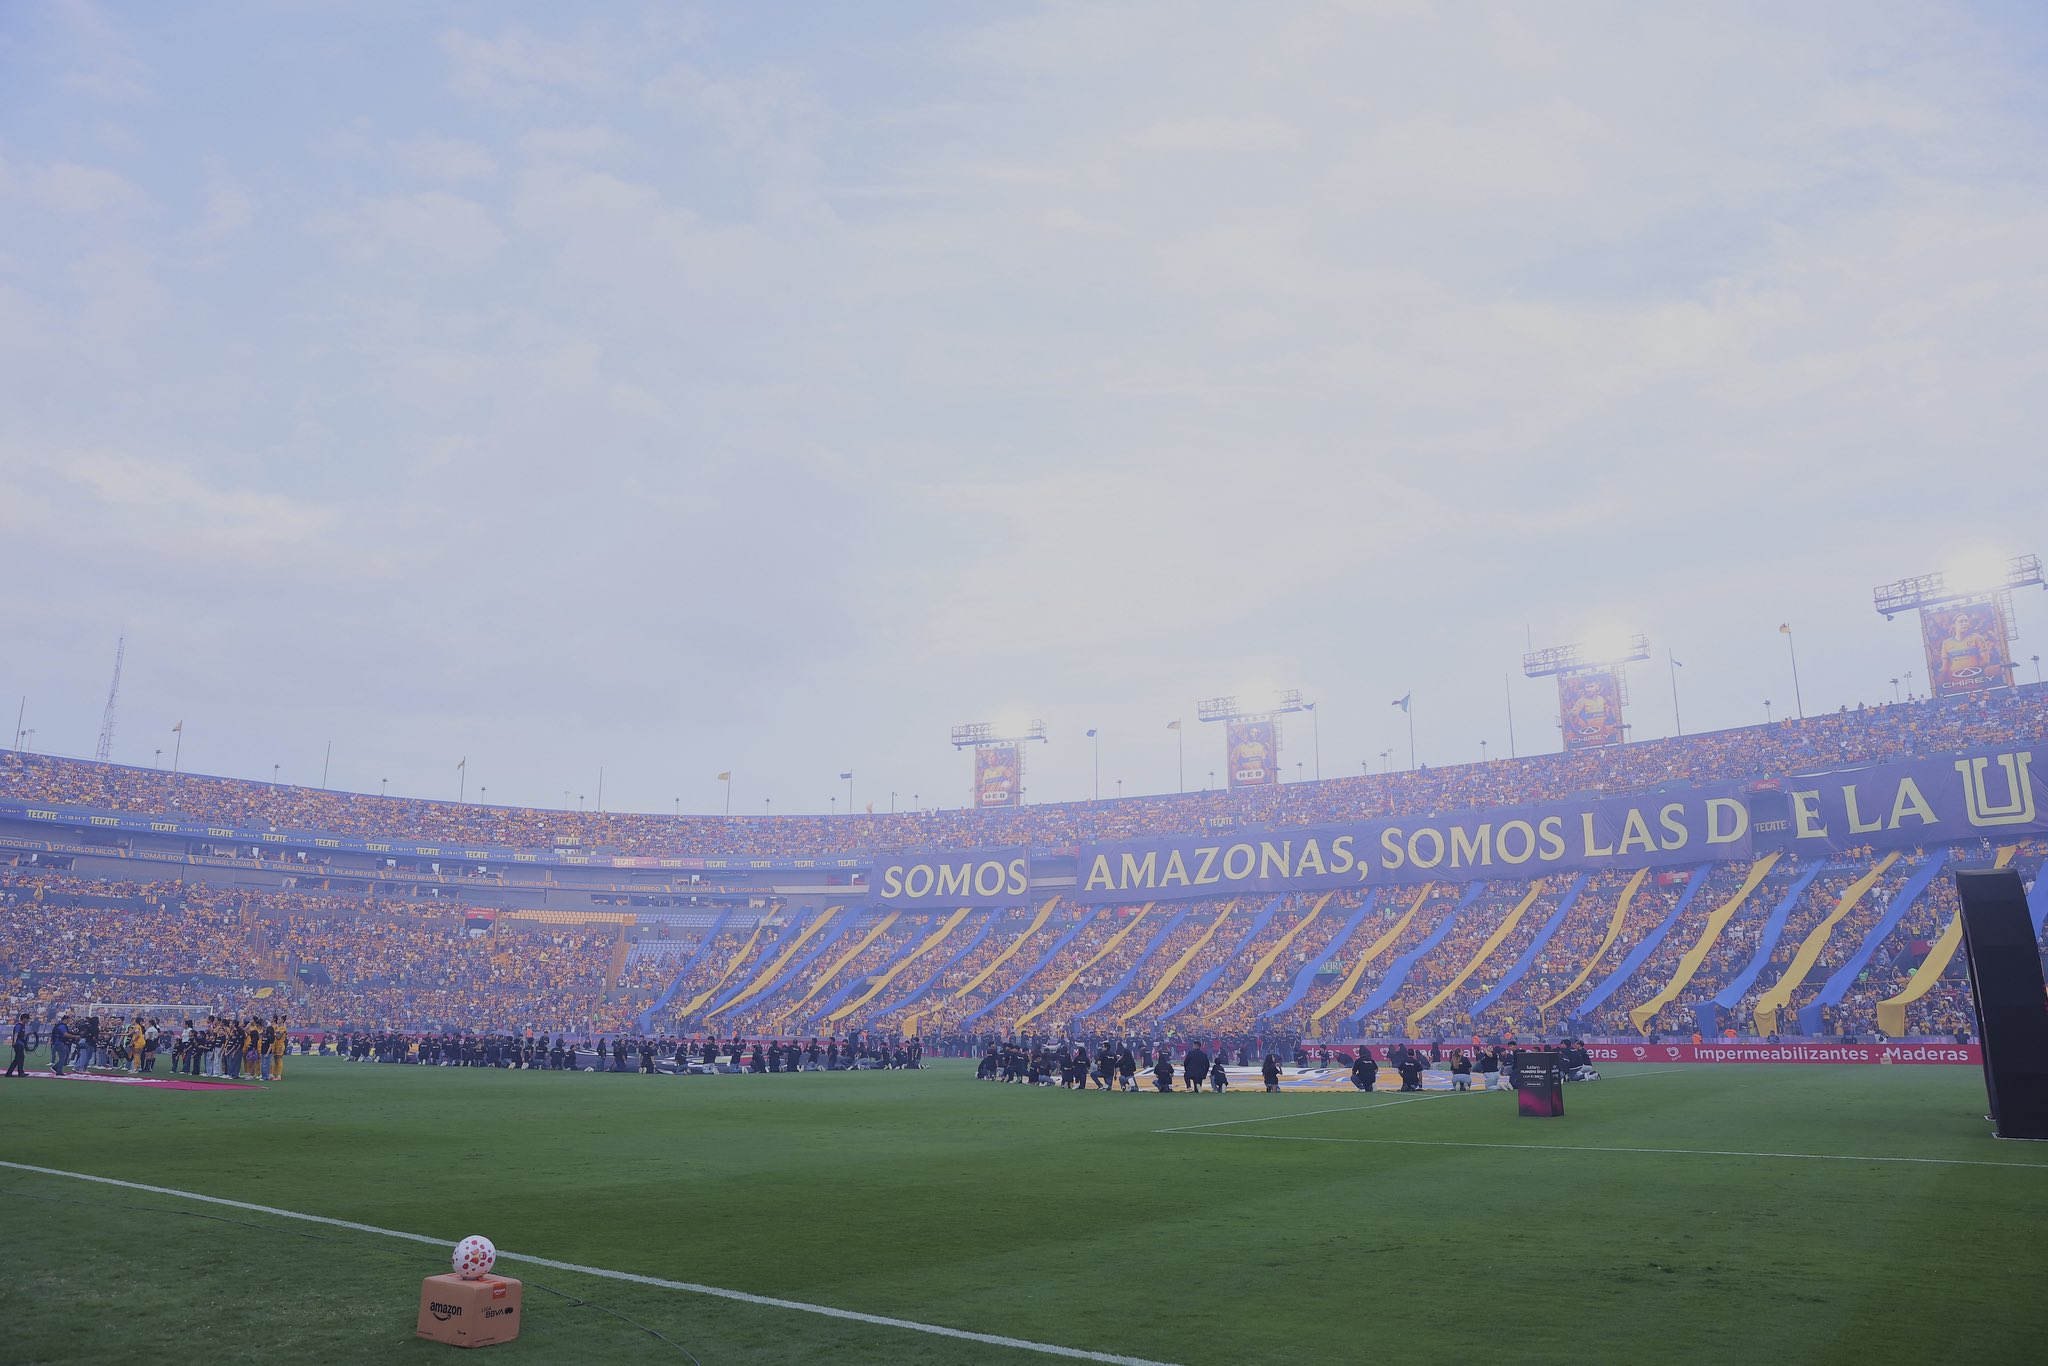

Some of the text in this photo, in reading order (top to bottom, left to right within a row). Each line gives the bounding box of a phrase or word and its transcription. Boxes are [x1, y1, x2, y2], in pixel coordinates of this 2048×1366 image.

[1942, 675, 1995, 689] CHIREY
[1571, 733, 1610, 744] CHIREY
[880, 858, 1028, 898] SOMOS
[1084, 836, 1368, 891] AMAZONAS,
[1381, 816, 1566, 869] SOMOS
[1580, 803, 1689, 857] LAS
[1841, 777, 1941, 834] LA
[1954, 752, 2036, 827] U
[1209, 817, 1234, 826] TECATE
[1753, 820, 1787, 832] TECATE
[26, 809, 58, 820] TECATE
[89, 815, 120, 827] TECATE
[150, 822, 179, 833] TECATE
[207, 827, 235, 838] TECATE
[262, 833, 288, 843] TECATE
[314, 838, 340, 848] TECATE
[365, 842, 391, 852] TECATE
[416, 847, 440, 856] TECATE
[465, 850, 489, 859] TECATE
[513, 853, 537, 862] TECATE
[566, 856, 590, 865] TECATE
[613, 857, 636, 866] TECATE
[660, 859, 682, 868] TECATE
[706, 860, 728, 868] TECATE
[750, 860, 772, 868] TECATE
[794, 860, 815, 868] TECATE
[837, 859, 859, 867] TECATE
[556, 836, 581, 846] TECATE
[67, 846, 94, 854] CARLOS
[168, 853, 184, 861] BOY
[273, 863, 316, 873] BARBADILLO
[335, 868, 354, 876] PILAR
[355, 870, 376, 878] REYES
[1694, 1047, 1869, 1062] Impermeabilizantes
[1885, 1046, 1969, 1061] Maderas
[430, 1301, 462, 1316] amazon
[485, 1309, 504, 1318] BBVA
